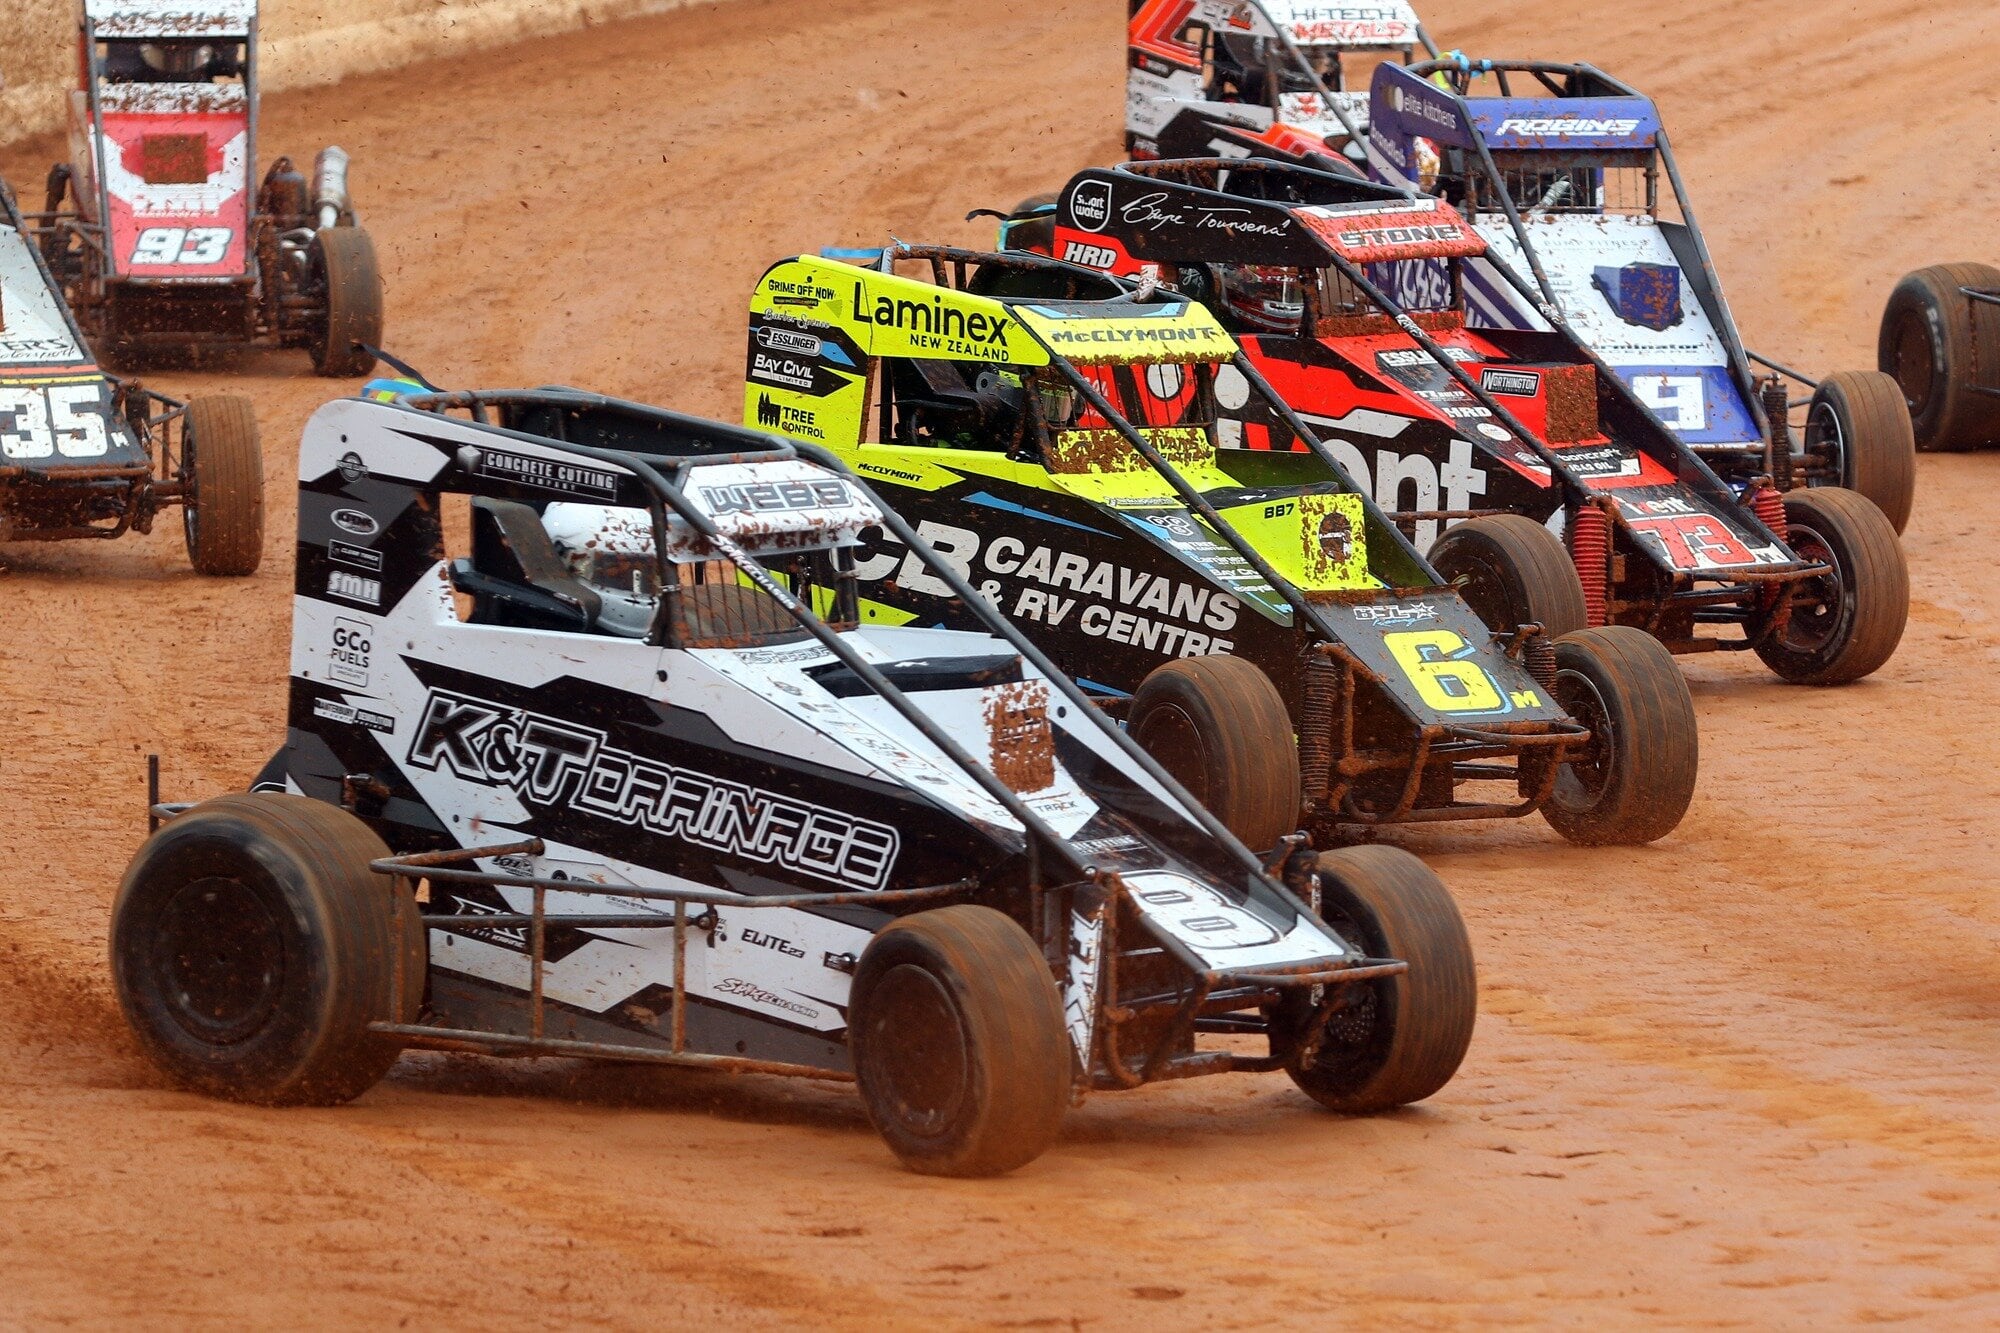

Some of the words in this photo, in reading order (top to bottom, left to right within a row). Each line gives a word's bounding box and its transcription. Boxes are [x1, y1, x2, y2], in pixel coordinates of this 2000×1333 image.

[1291, 8, 1396, 20] HI-TECH
[1495, 119, 1641, 136] ROBINS
[1076, 194, 1105, 209] sart
[1075, 205, 1104, 220] water
[128, 226, 232, 265] 93
[1338, 224, 1464, 247] STONE
[1063, 241, 1117, 269] HRD
[768, 279, 795, 293] GRIME
[797, 284, 813, 296] OFF
[815, 287, 835, 300] NOW
[853, 282, 1009, 347] Laminex
[772, 332, 817, 350] ESSLINGER
[1051, 326, 1215, 343] McCLYMONT
[910, 333, 941, 349] NEW
[947, 339, 1009, 362] ZEALAND
[755, 354, 783, 377] BAY
[783, 359, 814, 379] CIVIL
[778, 376, 809, 387] LIMITED
[1482, 371, 1537, 391] WORTHINGTON
[0, 385, 108, 458] 35
[782, 405, 815, 425] TREE
[1441, 406, 1493, 418] HRD
[781, 421, 826, 439] CONTROL
[486, 453, 553, 477] CONCRETE
[558, 468, 614, 489] CUTTING
[857, 462, 923, 482] McCLYMONT
[520, 474, 577, 491] COMPANY
[698, 478, 853, 517] WEBB
[1264, 503, 1295, 519] BB7
[1630, 514, 1757, 570] 73
[984, 536, 1241, 632] CARAVANS
[977, 579, 1003, 612] &
[1013, 587, 1080, 627] RV
[333, 627, 371, 654] GCo
[330, 648, 370, 668] FUELS
[1384, 630, 1503, 711] 6
[1509, 691, 1541, 708] M
[406, 686, 607, 805] K&T
[571, 747, 900, 893] DRAINAGE
[1035, 802, 1078, 813] TRACK
